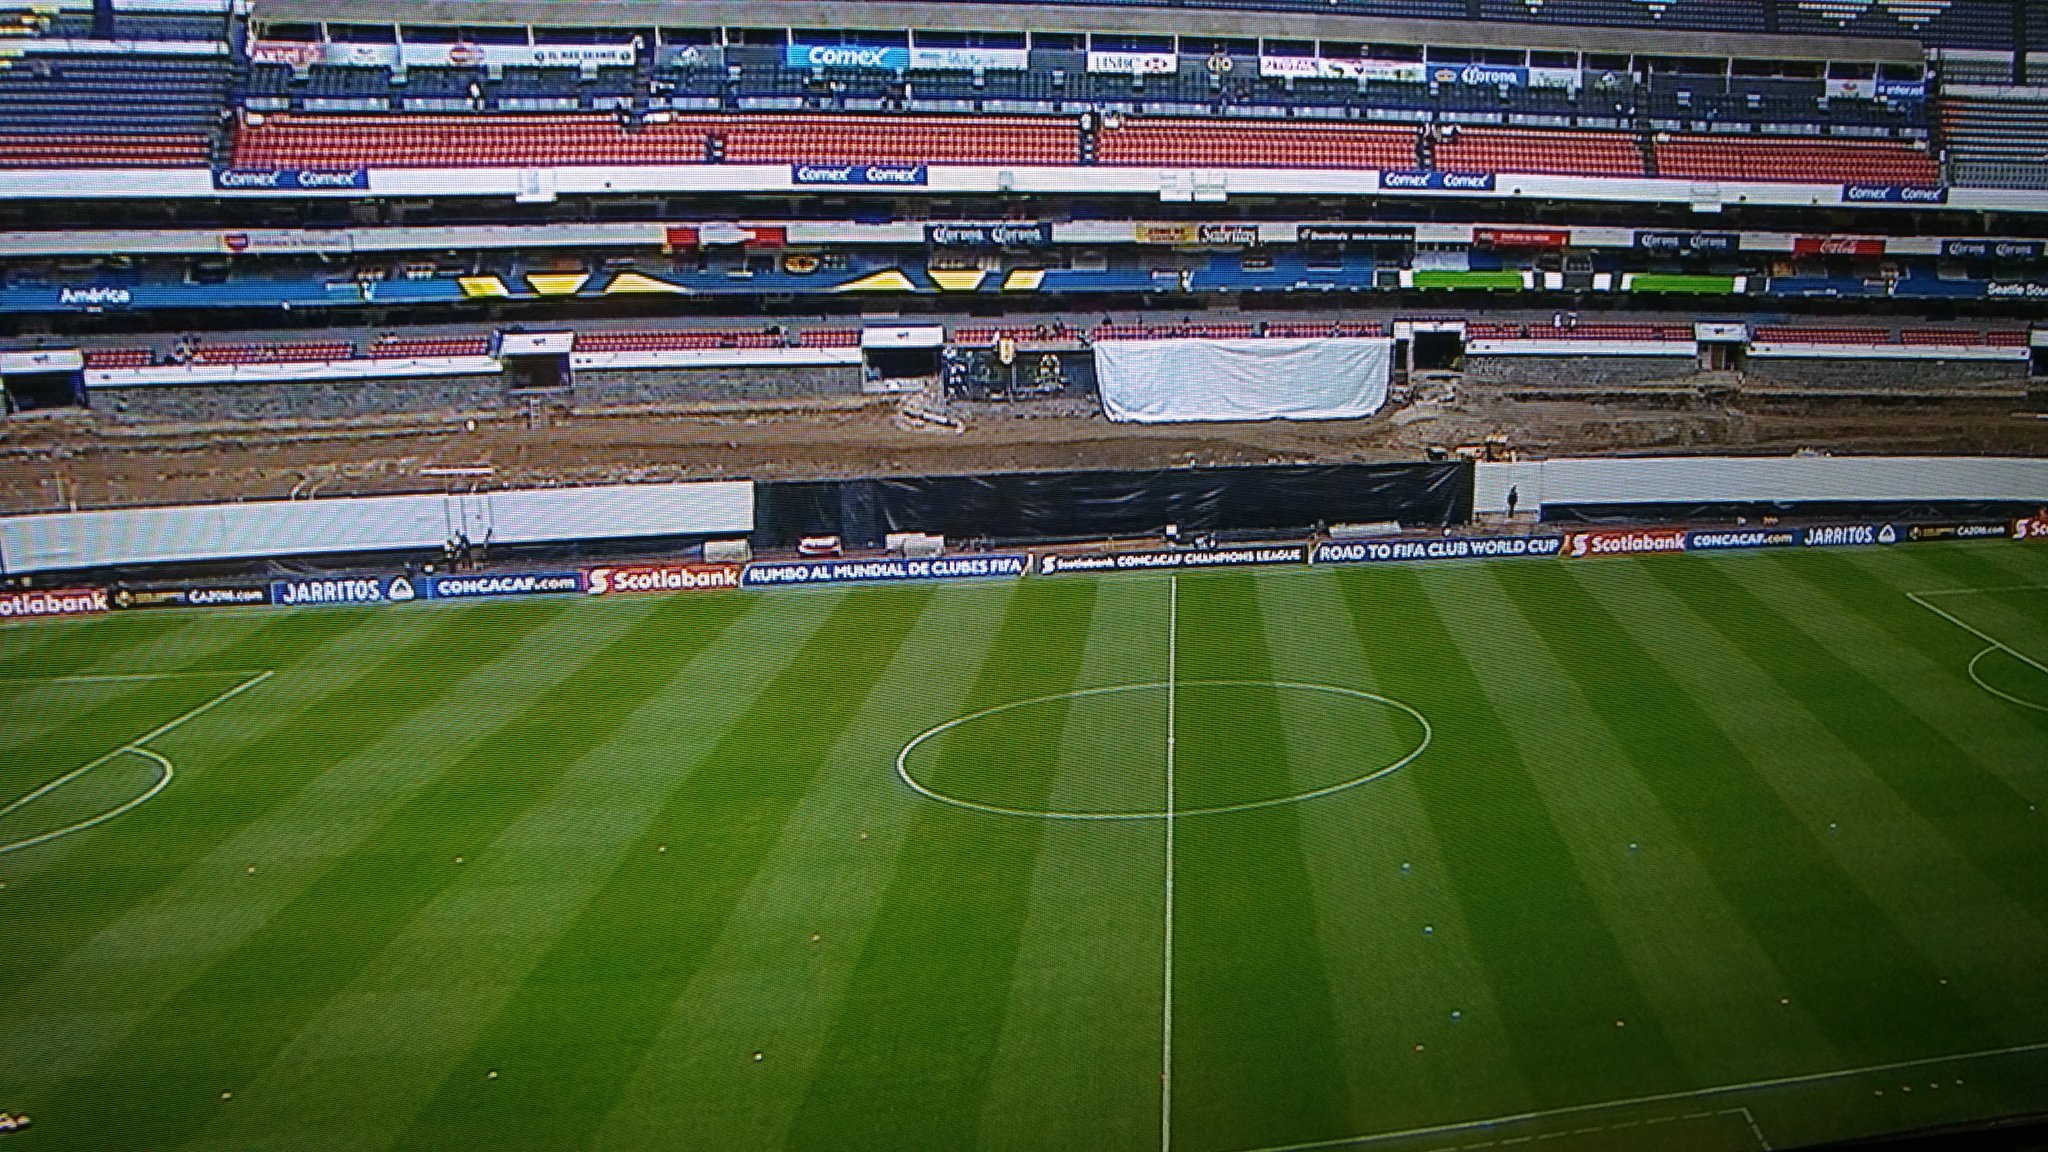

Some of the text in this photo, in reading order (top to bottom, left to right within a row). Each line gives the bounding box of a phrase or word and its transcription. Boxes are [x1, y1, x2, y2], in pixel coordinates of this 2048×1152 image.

[1461, 65, 1518, 86] Corona
[219, 169, 358, 187] Comex Comex
[799, 165, 920, 182] Comex Comex
[1384, 172, 1490, 188] Comex Comex
[1848, 185, 1942, 201] Comex Comex
[60, 287, 131, 303] América
[1590, 534, 1686, 553] Scotiabank
[1692, 532, 1793, 547] CONCACAF.com
[1803, 526, 1875, 546] JARRITOS
[1319, 538, 1560, 562] ROAD TO FIFA CLUB WORLD CUP
[613, 566, 739, 592] Scotiabank
[749, 557, 1023, 583] RUMBO AL MUNDIAL DE CLUBES FIFA
[282, 579, 379, 604] JARRITOS
[436, 576, 575, 597] CONCACAF.com
